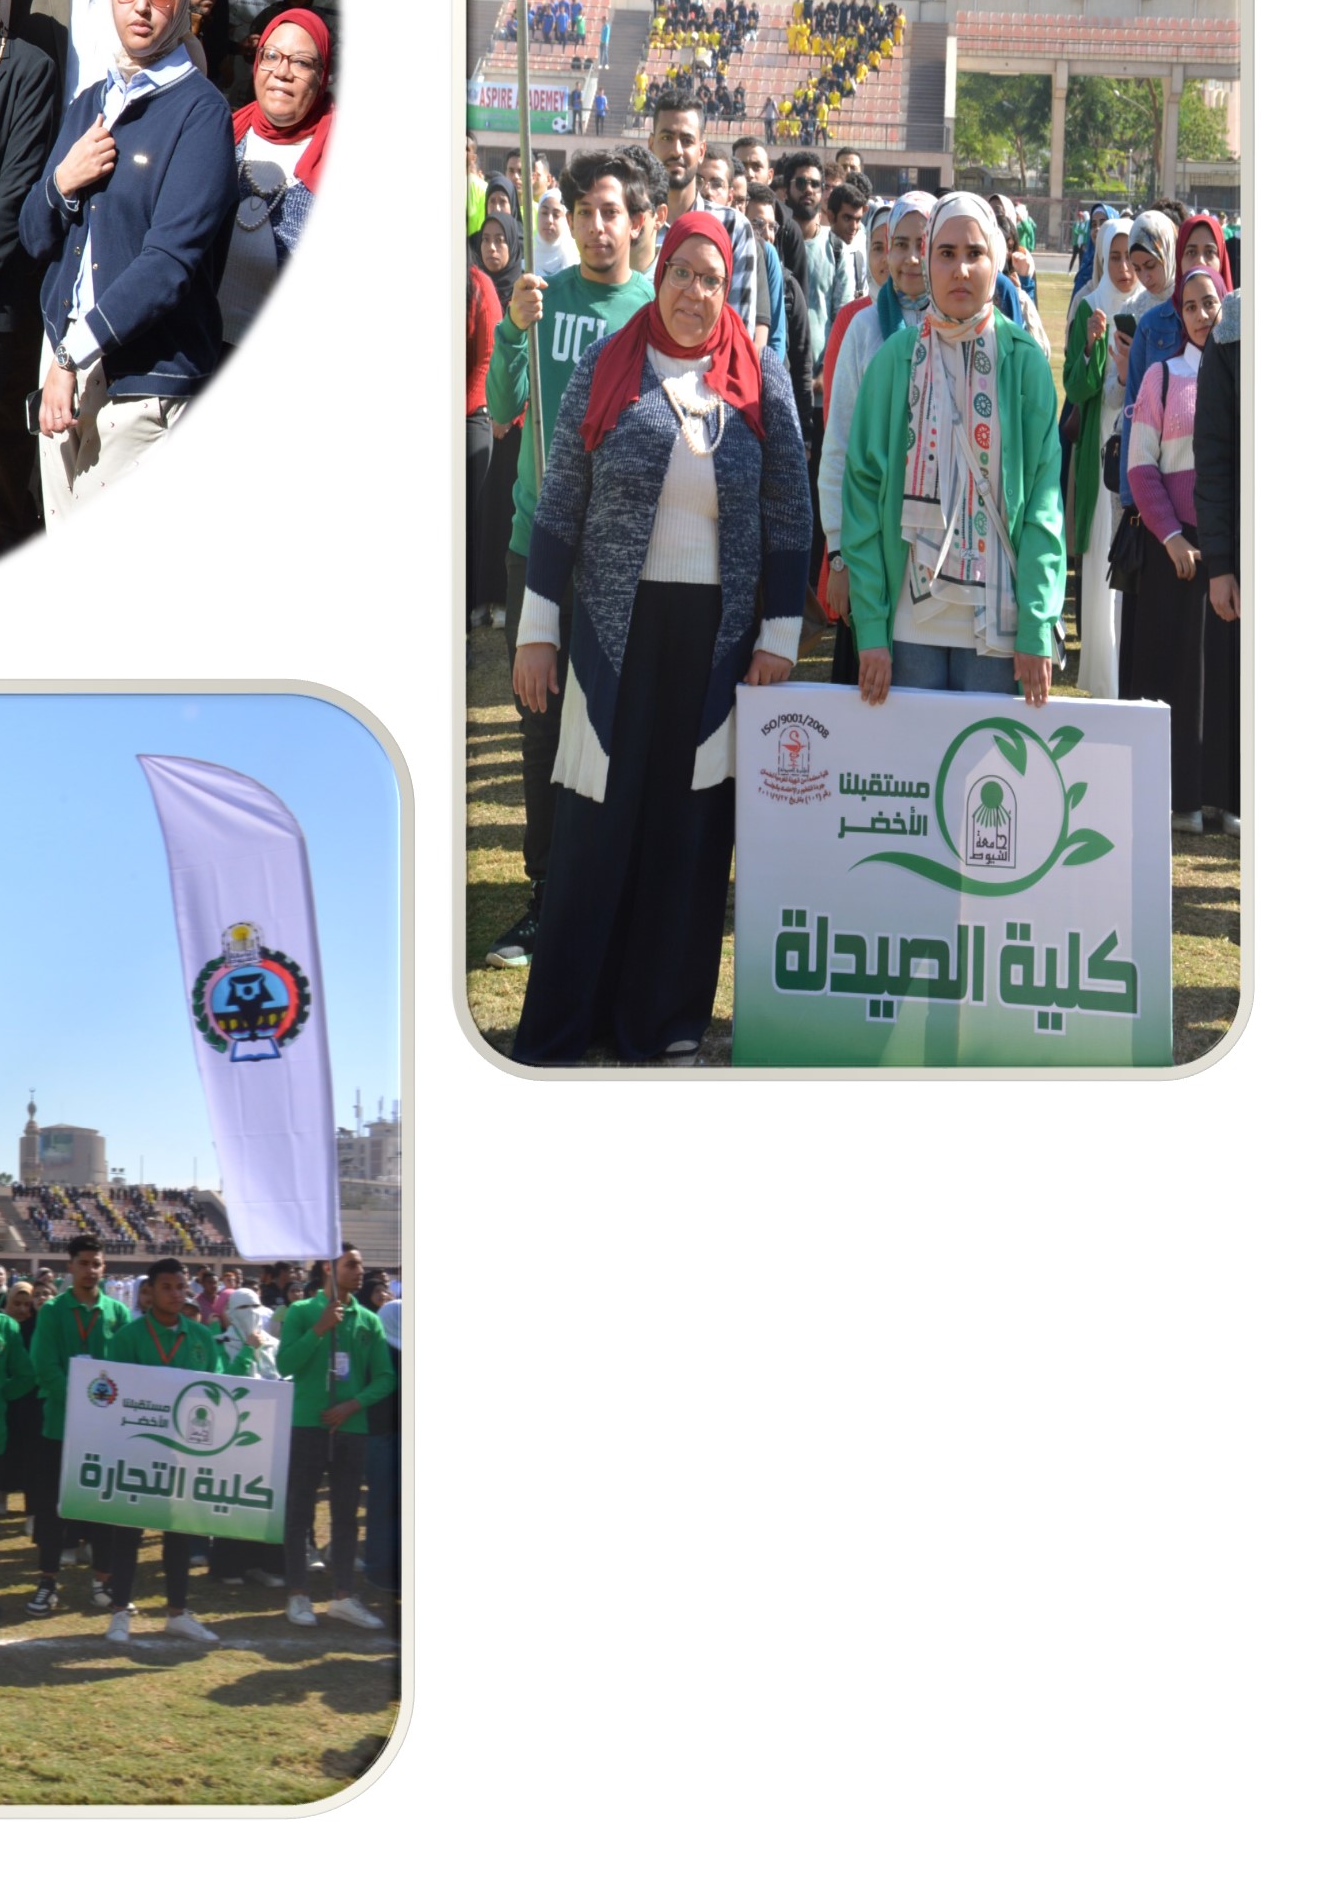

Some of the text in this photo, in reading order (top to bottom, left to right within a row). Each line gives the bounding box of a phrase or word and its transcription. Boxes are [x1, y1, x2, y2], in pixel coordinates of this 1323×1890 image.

[479, 86, 513, 109] ASPIRE
[760, 712, 830, 739] ISO/9001/2008
[838, 771, 930, 802] مستقبلنا
[837, 806, 928, 839] الأخضر
[775, 908, 1139, 1032] كلية الصيدلة
[79, 1452, 274, 1514] كلية التجارة
